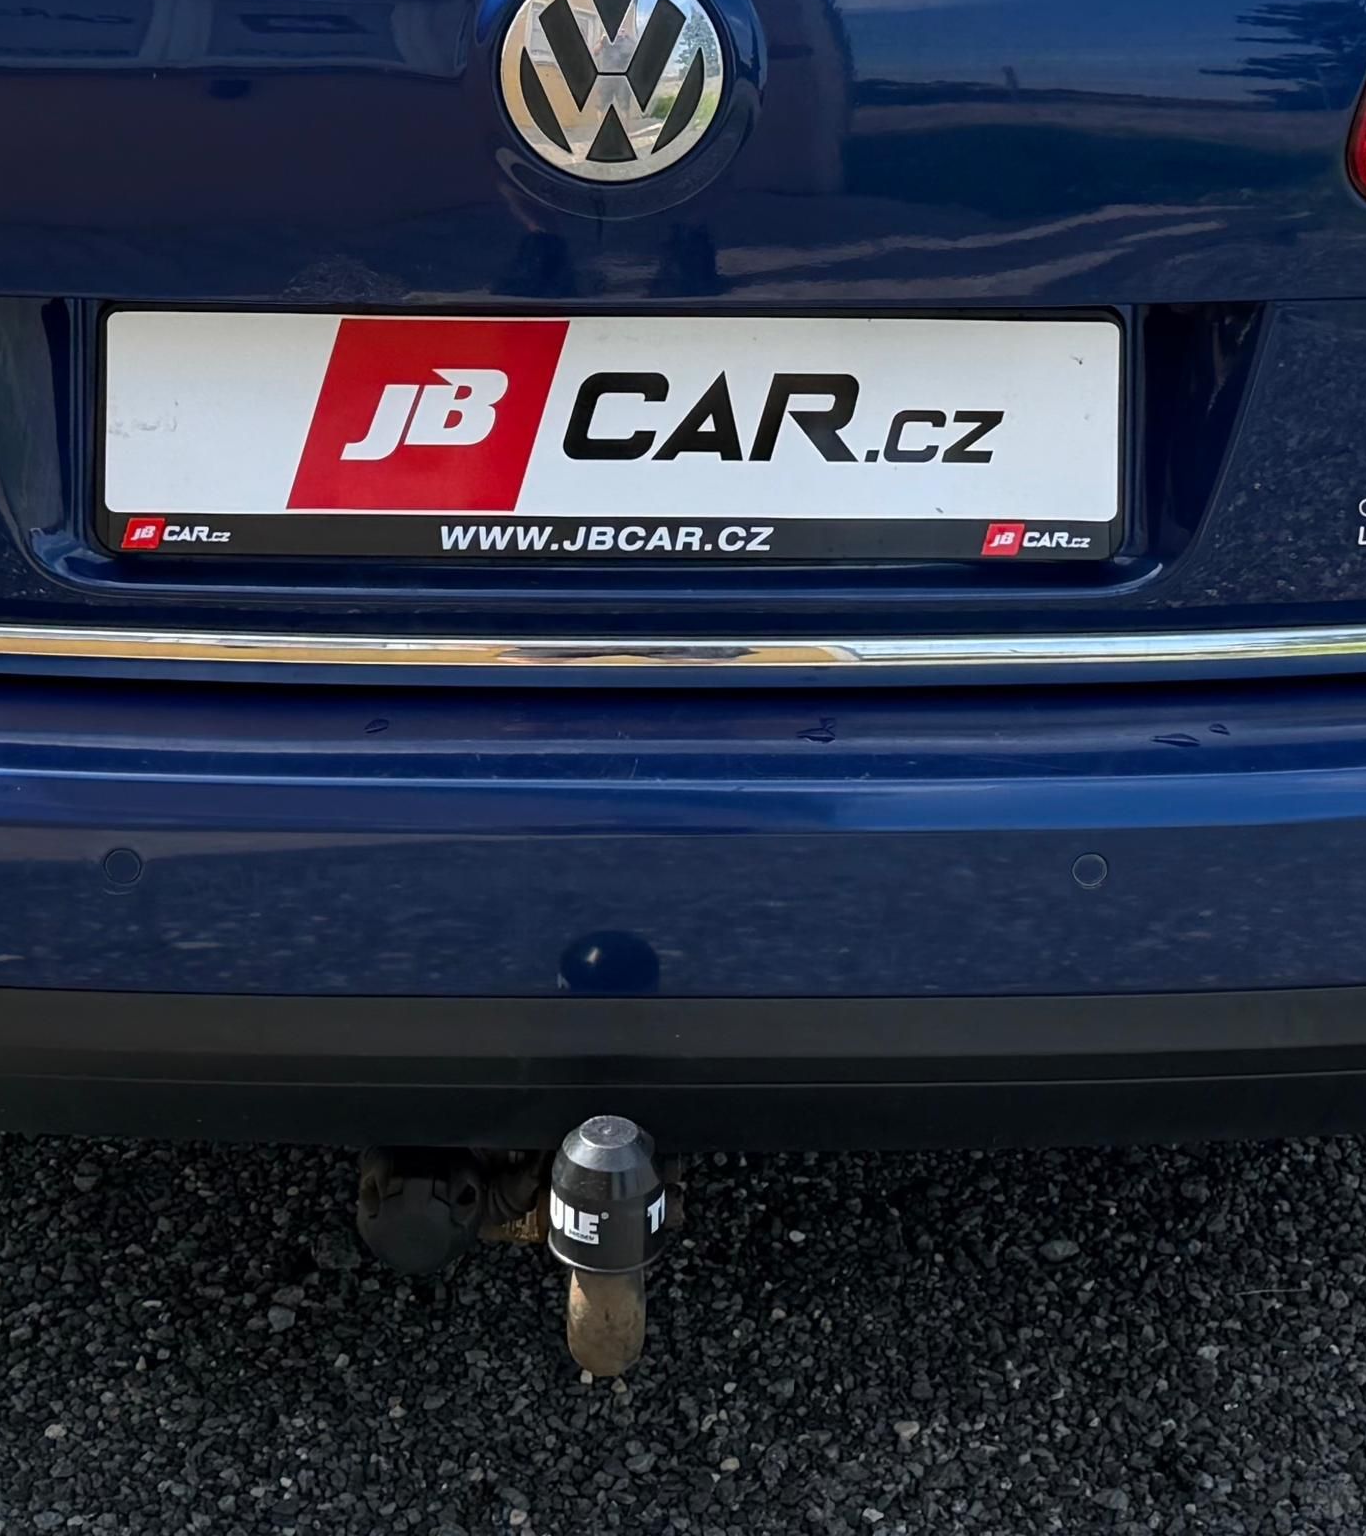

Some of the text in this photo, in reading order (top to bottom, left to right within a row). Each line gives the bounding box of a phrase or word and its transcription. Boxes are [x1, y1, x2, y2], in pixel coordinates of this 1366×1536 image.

[340, 368, 509, 461] JB
[130, 525, 156, 541] JB
[440, 526, 774, 552] WWW.JBCAR.CZ
[989, 532, 1015, 548] JB
